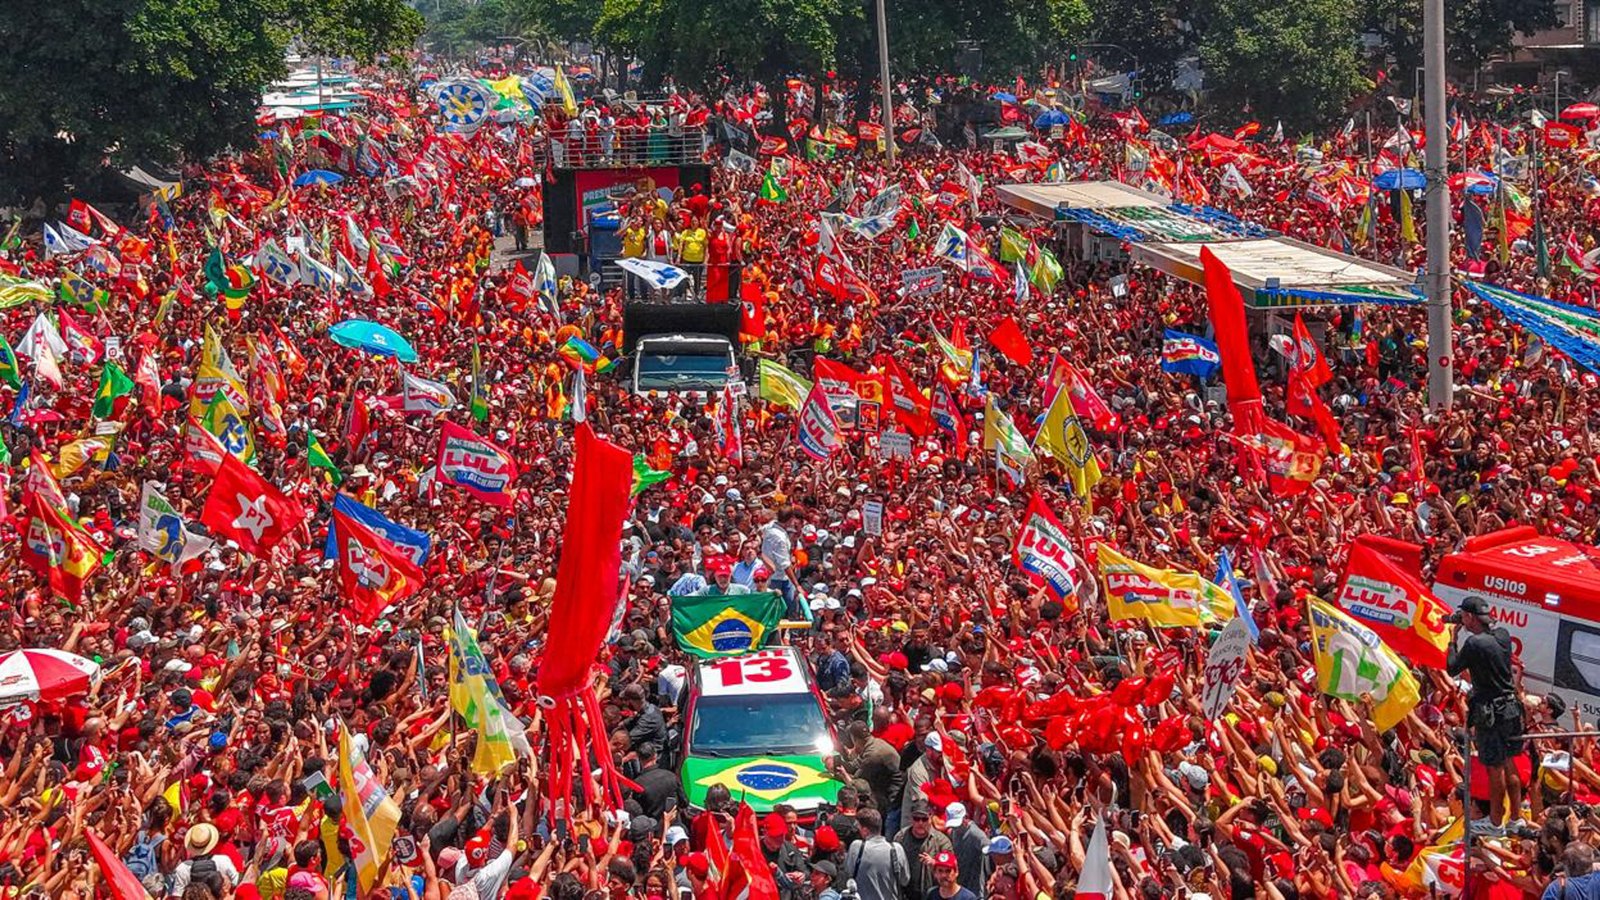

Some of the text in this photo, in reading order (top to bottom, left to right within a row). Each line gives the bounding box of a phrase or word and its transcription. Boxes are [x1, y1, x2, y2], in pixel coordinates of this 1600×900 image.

[857, 382, 876, 400] 13
[245, 505, 267, 527] PT
[1483, 574, 1527, 596] USI09
[1343, 586, 1409, 615] LULA
[1488, 605, 1529, 628] AMU
[710, 657, 793, 688] 13
